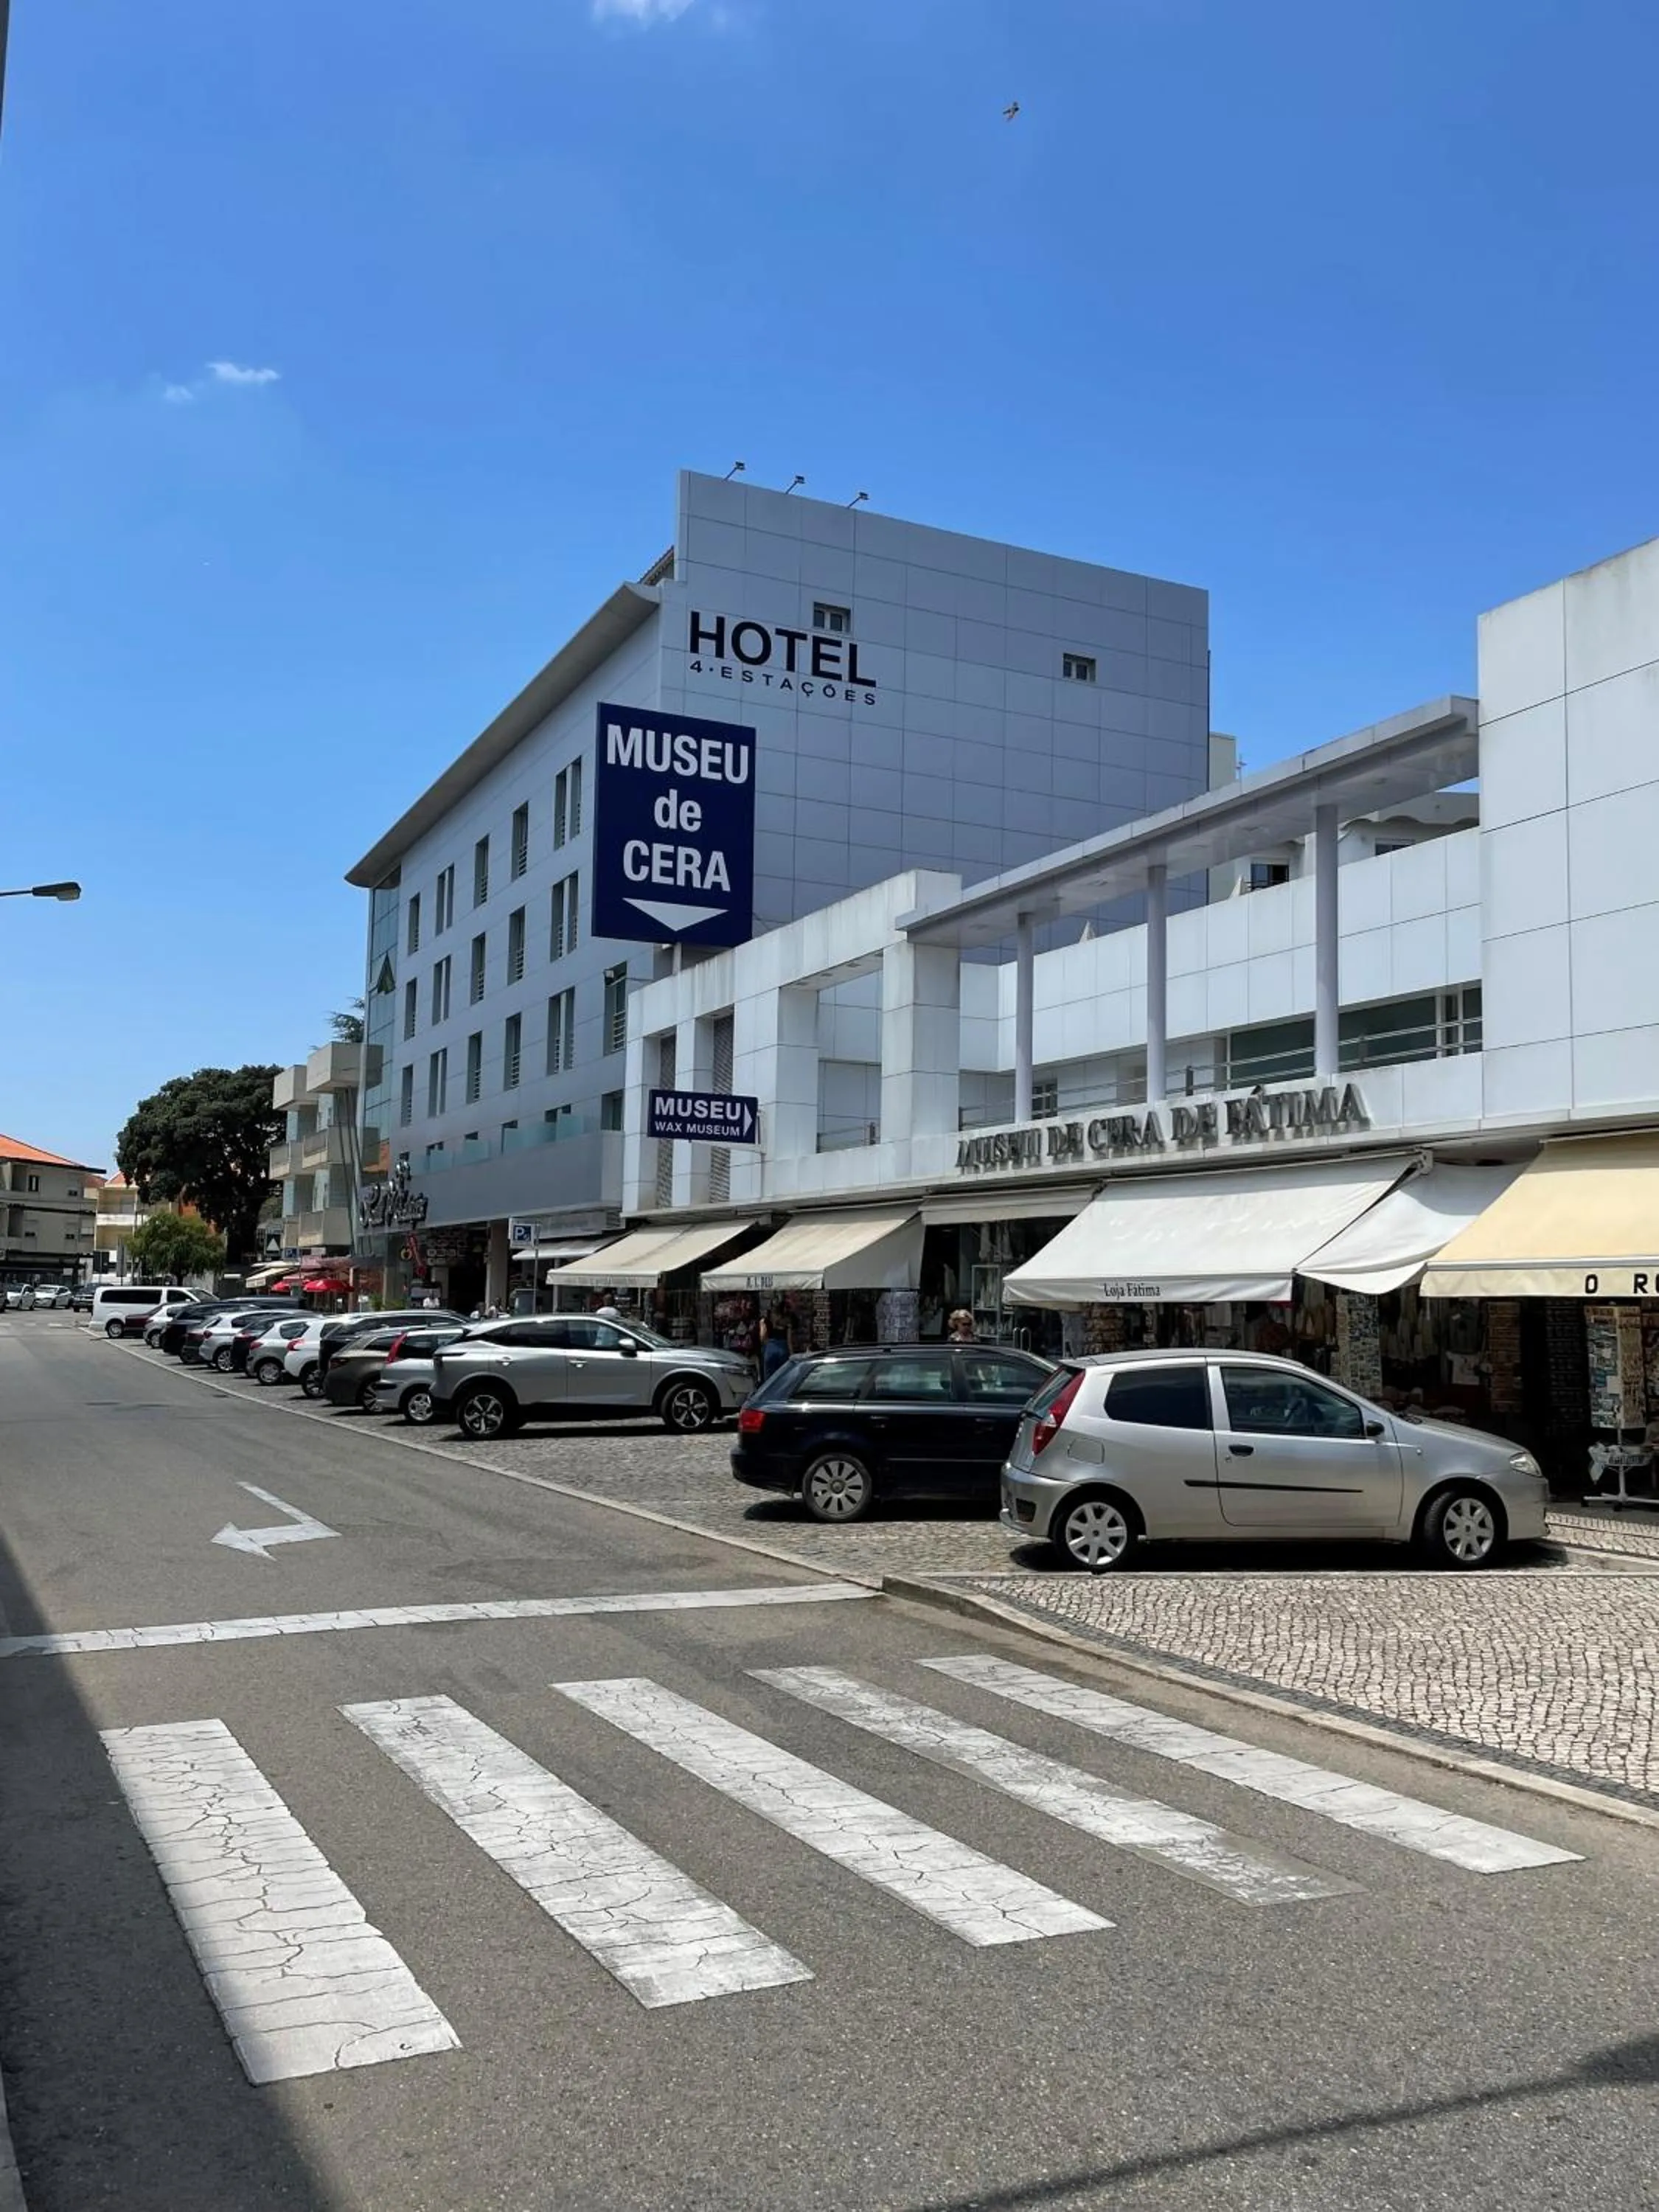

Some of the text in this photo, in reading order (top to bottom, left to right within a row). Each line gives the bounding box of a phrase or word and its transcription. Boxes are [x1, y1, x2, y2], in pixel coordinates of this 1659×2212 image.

[689, 611, 877, 688] HOTEL
[606, 723, 749, 784] MUSEU
[653, 789, 702, 832] de
[622, 839, 731, 892] CERA
[655, 1096, 741, 1120] MUSEU
[655, 1121, 740, 1136] WAX MUSEUM
[955, 1083, 1371, 1169] MUSEU DE CERA DE FÁTIMA
[515, 1227, 524, 1239] P
[1104, 1283, 1125, 1301] Loja
[1585, 1273, 1599, 1294] O
